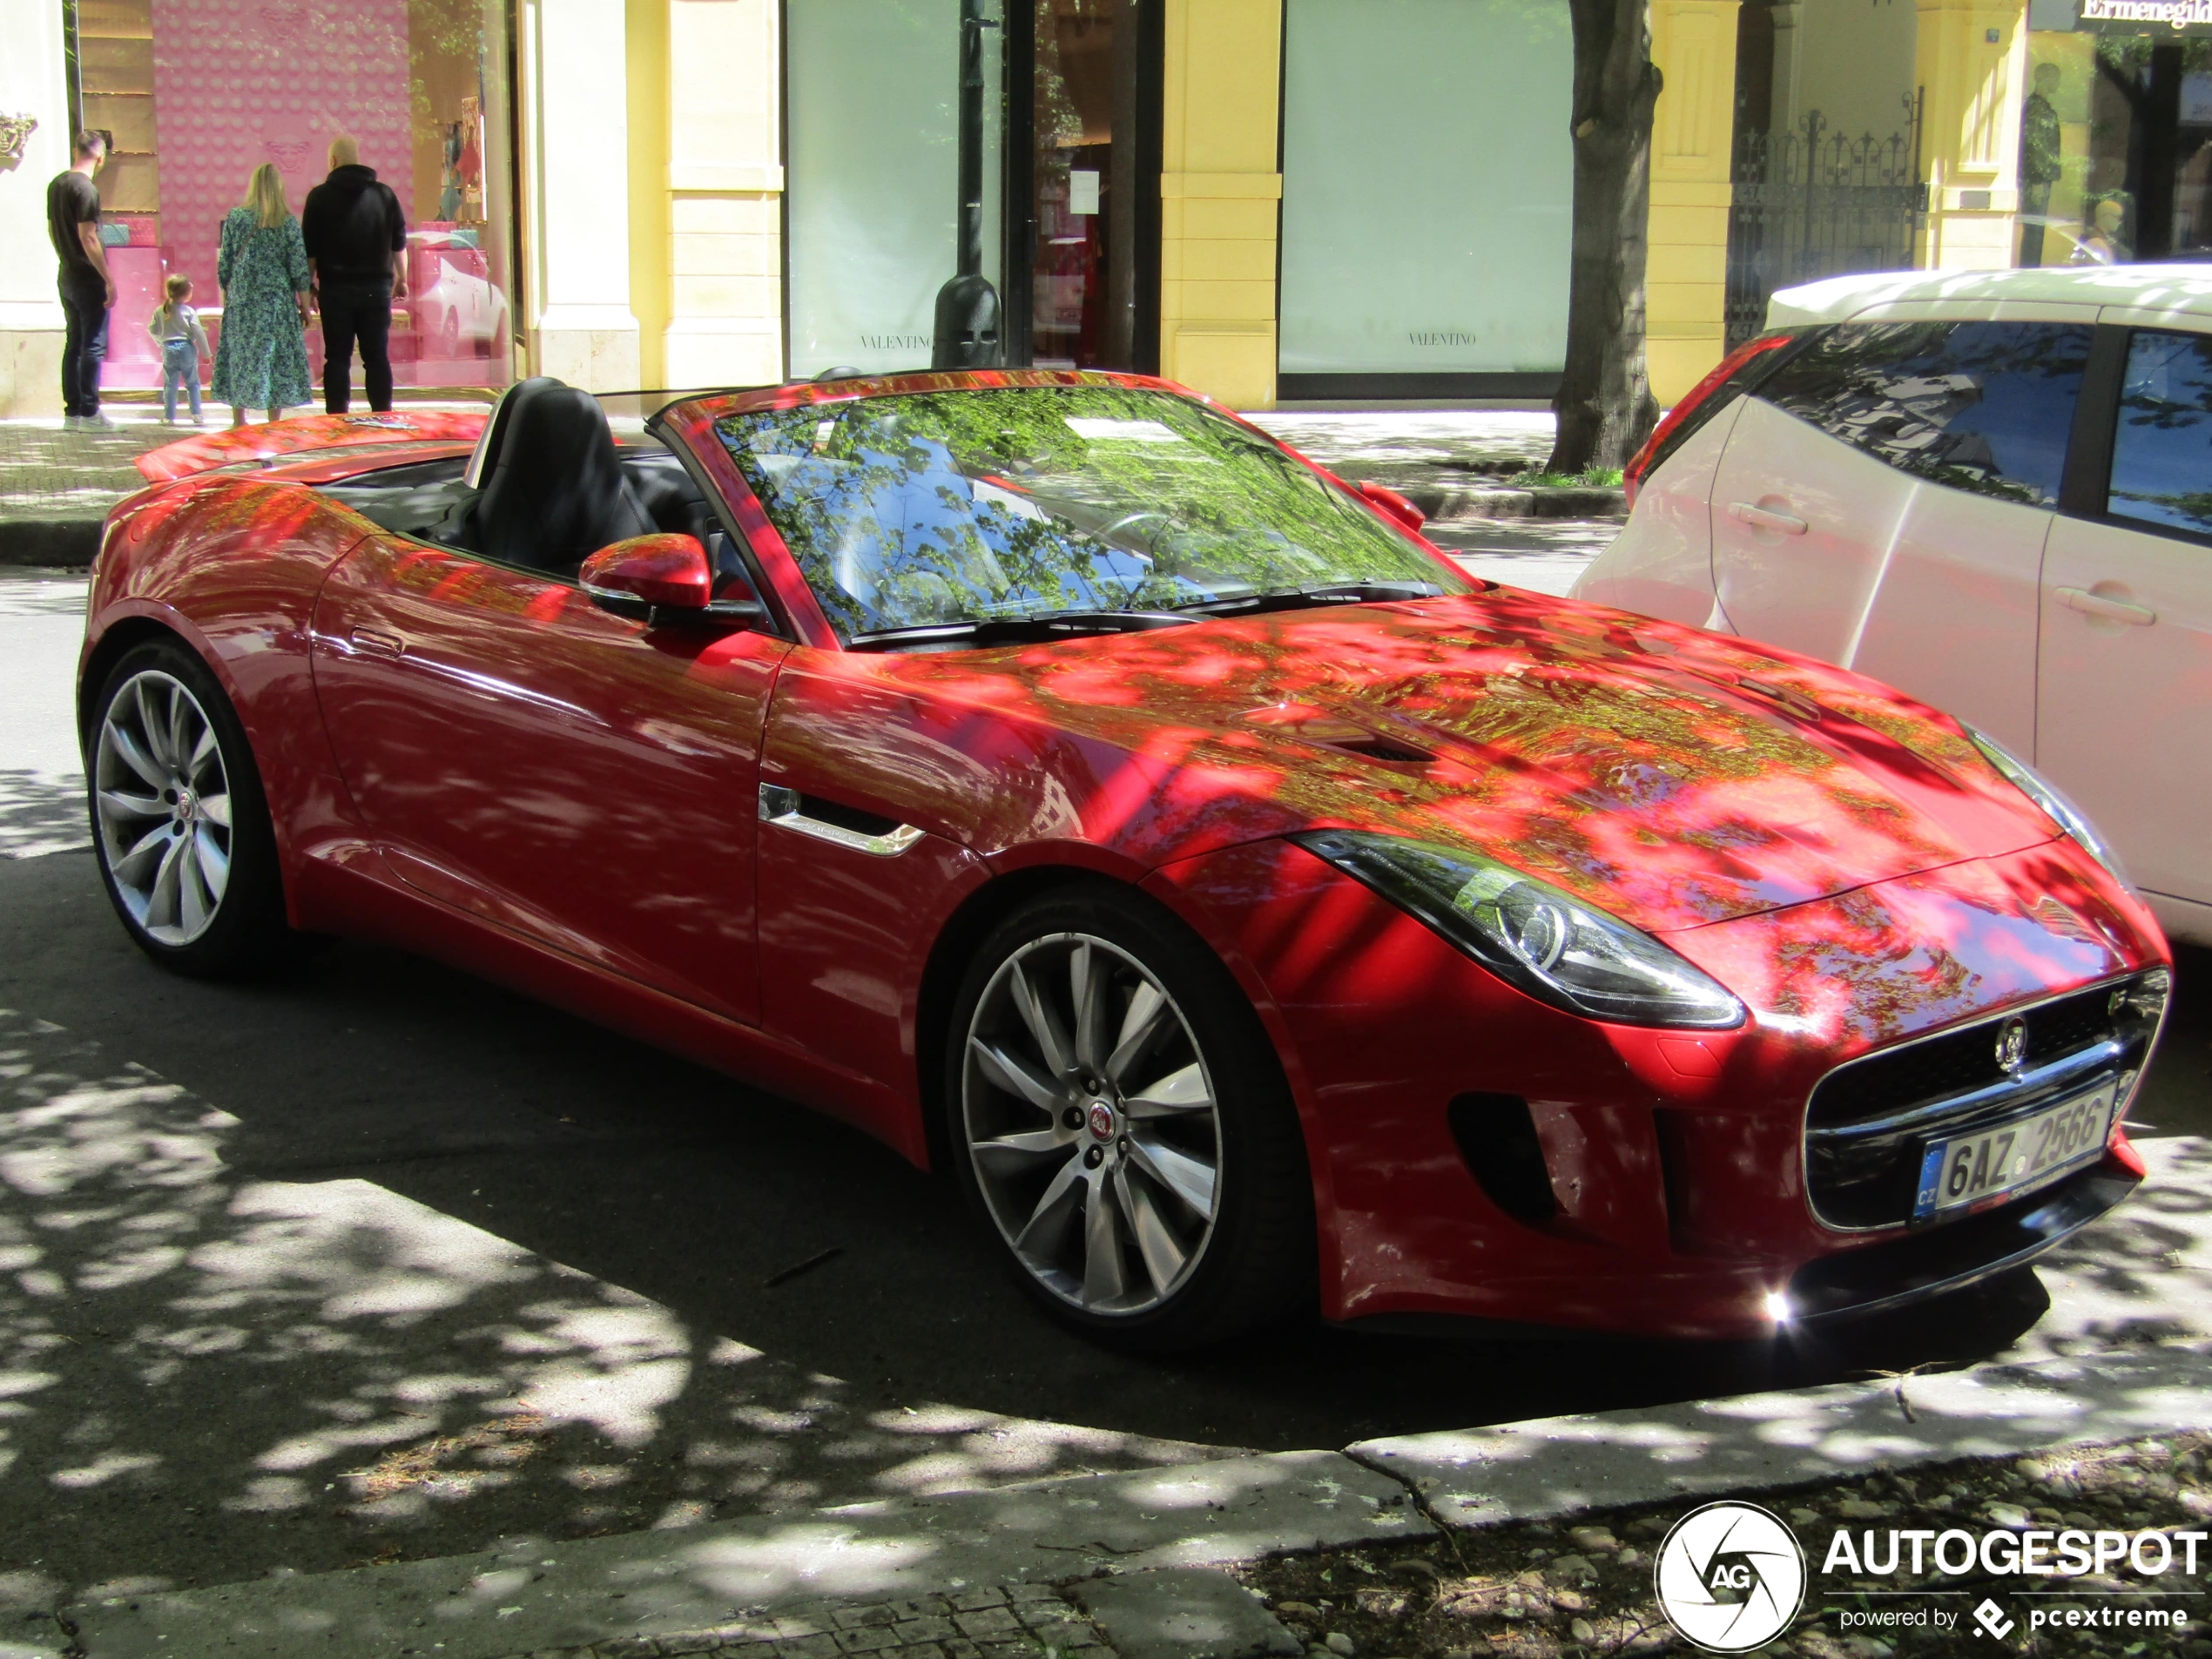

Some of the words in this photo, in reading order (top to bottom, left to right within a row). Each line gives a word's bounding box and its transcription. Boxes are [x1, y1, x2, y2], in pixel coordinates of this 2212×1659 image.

[2080, 0, 2212, 30] Ermenegild
[1409, 333, 1476, 346] VALENTINO
[1947, 1131, 2016, 1197] 6AZ
[2030, 1096, 2102, 1171] 2566
[1918, 1187, 1936, 1206] CZ
